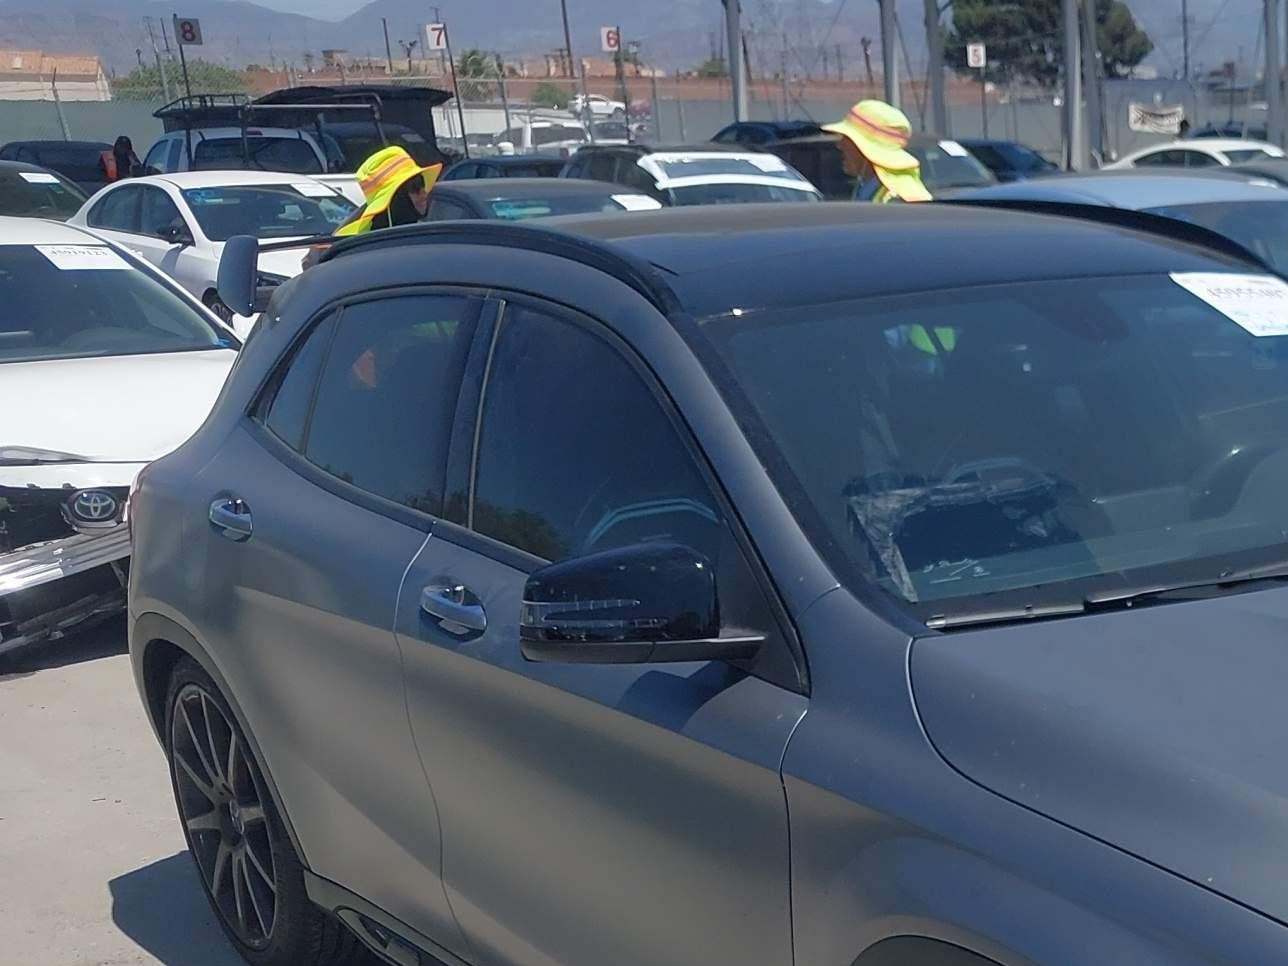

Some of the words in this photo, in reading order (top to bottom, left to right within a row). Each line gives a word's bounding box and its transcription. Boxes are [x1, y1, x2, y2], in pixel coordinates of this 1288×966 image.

[180, 20, 197, 42] 8
[431, 26, 444, 46] 7
[606, 30, 619, 48] 6
[971, 47, 982, 65] 5
